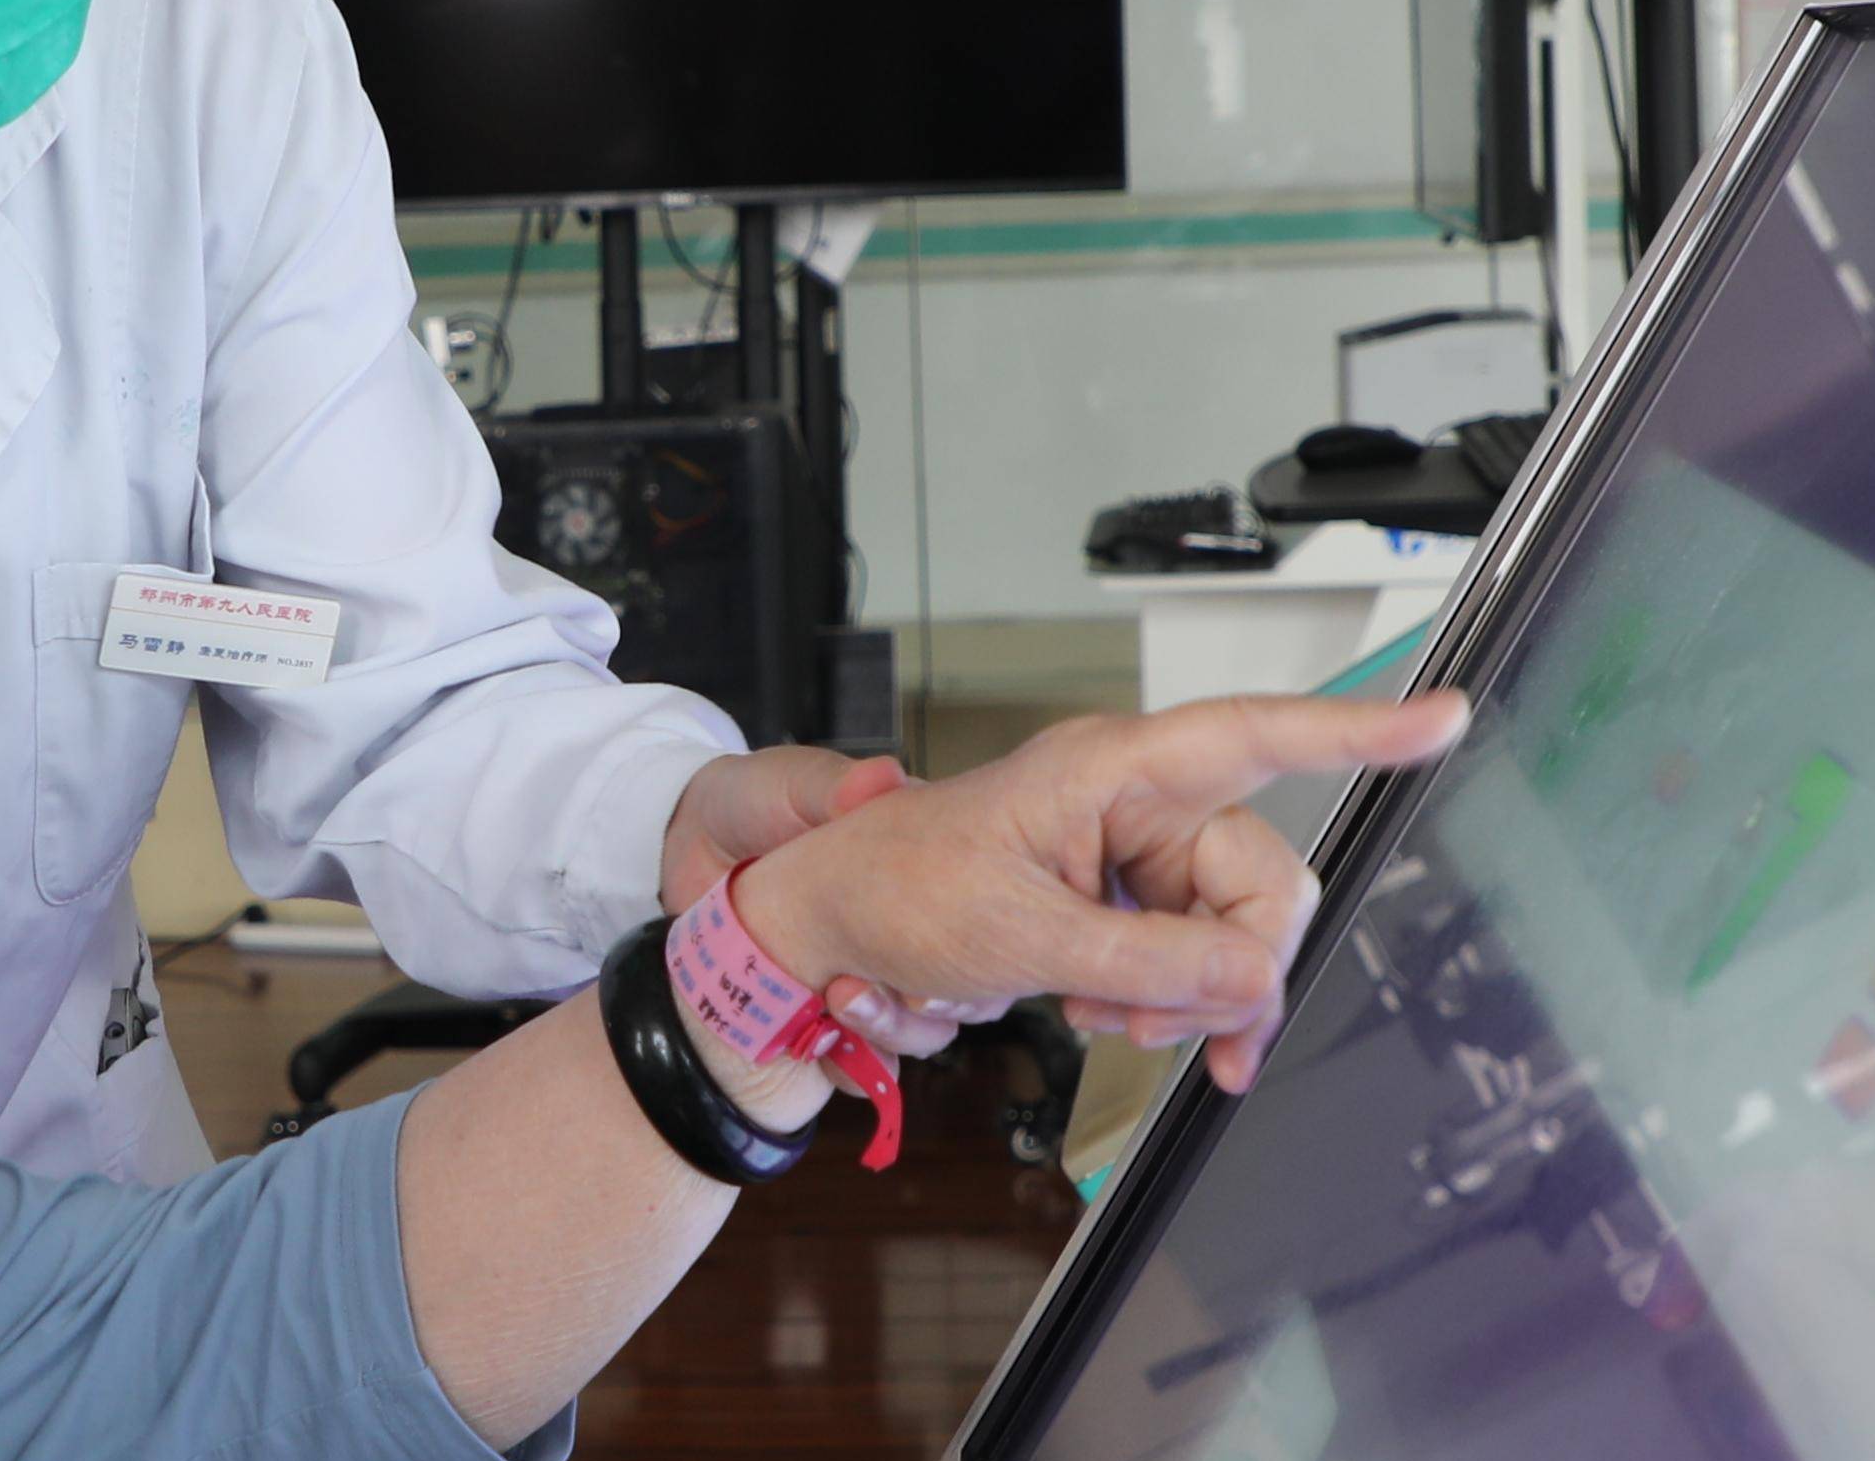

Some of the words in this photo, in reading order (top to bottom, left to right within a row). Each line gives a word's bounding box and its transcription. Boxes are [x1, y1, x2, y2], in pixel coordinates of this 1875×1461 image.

[139, 587, 313, 623] 郑州市第九人民医院
